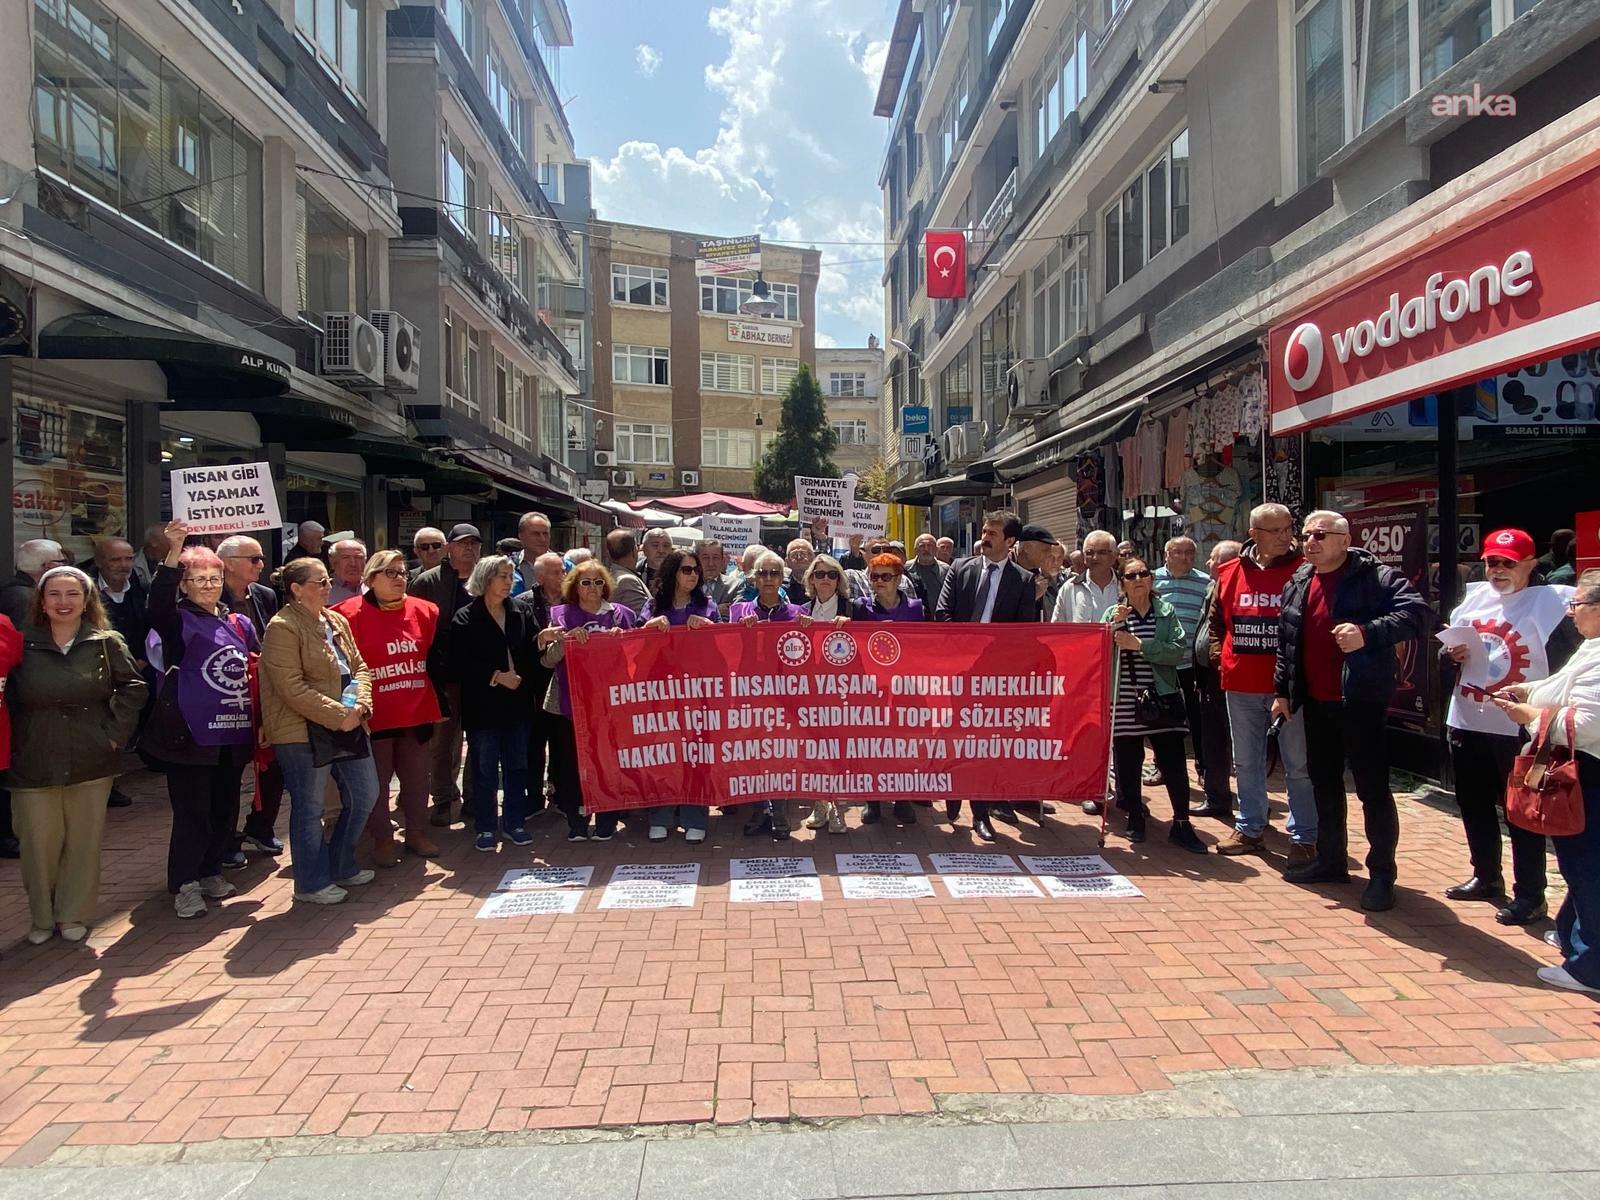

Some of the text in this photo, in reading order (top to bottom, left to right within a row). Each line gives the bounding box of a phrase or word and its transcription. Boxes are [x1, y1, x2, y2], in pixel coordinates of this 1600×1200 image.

[1331, 250, 1534, 364] vodafone
[741, 330, 766, 342] ABHAZ
[241, 355, 264, 368] ALP
[905, 413, 927, 422] beko
[1505, 425, 1587, 436] SARAÇ İLETİŞİM
[183, 465, 259, 484] İNSAN GİBİ
[800, 478, 847, 489] SERMAYEYE
[187, 486, 260, 502] YAŞAMAK
[806, 488, 839, 499] CENNET,
[804, 497, 842, 508] EMEKLİYE
[853, 502, 880, 511] UNUMA
[187, 503, 265, 520] İSTİYORUZ
[803, 507, 844, 518] CEHENNEM
[208, 521, 244, 532] EMEKLİ
[709, 525, 753, 533] YALANLARINA
[714, 532, 748, 541] GEÇİMİMİZİ
[1240, 591, 1282, 607] DİSK
[1235, 623, 1279, 635] EMEKLİ-SE
[387, 639, 418, 655] DİSK
[785, 643, 803, 652] DİSK
[1232, 636, 1280, 650] SAMSUN ŞUB
[379, 679, 412, 693] SAMSUN
[609, 671, 1065, 706] EMEKLİLİKTE İNSANCA YAŞAM, ONURLU EMEKLİLİK
[632, 701, 1051, 735] HALK İÇİN BÜTÇE, SENDİKALI TOPLU SÖZLEŞME
[617, 733, 1069, 769] HAKKI İÇİN SAMSUN'DAN ANKARA'YA YÜRÜYORUZ.
[729, 768, 952, 797] DEVRİMCİ EMEKLİLER SENDİKASI
